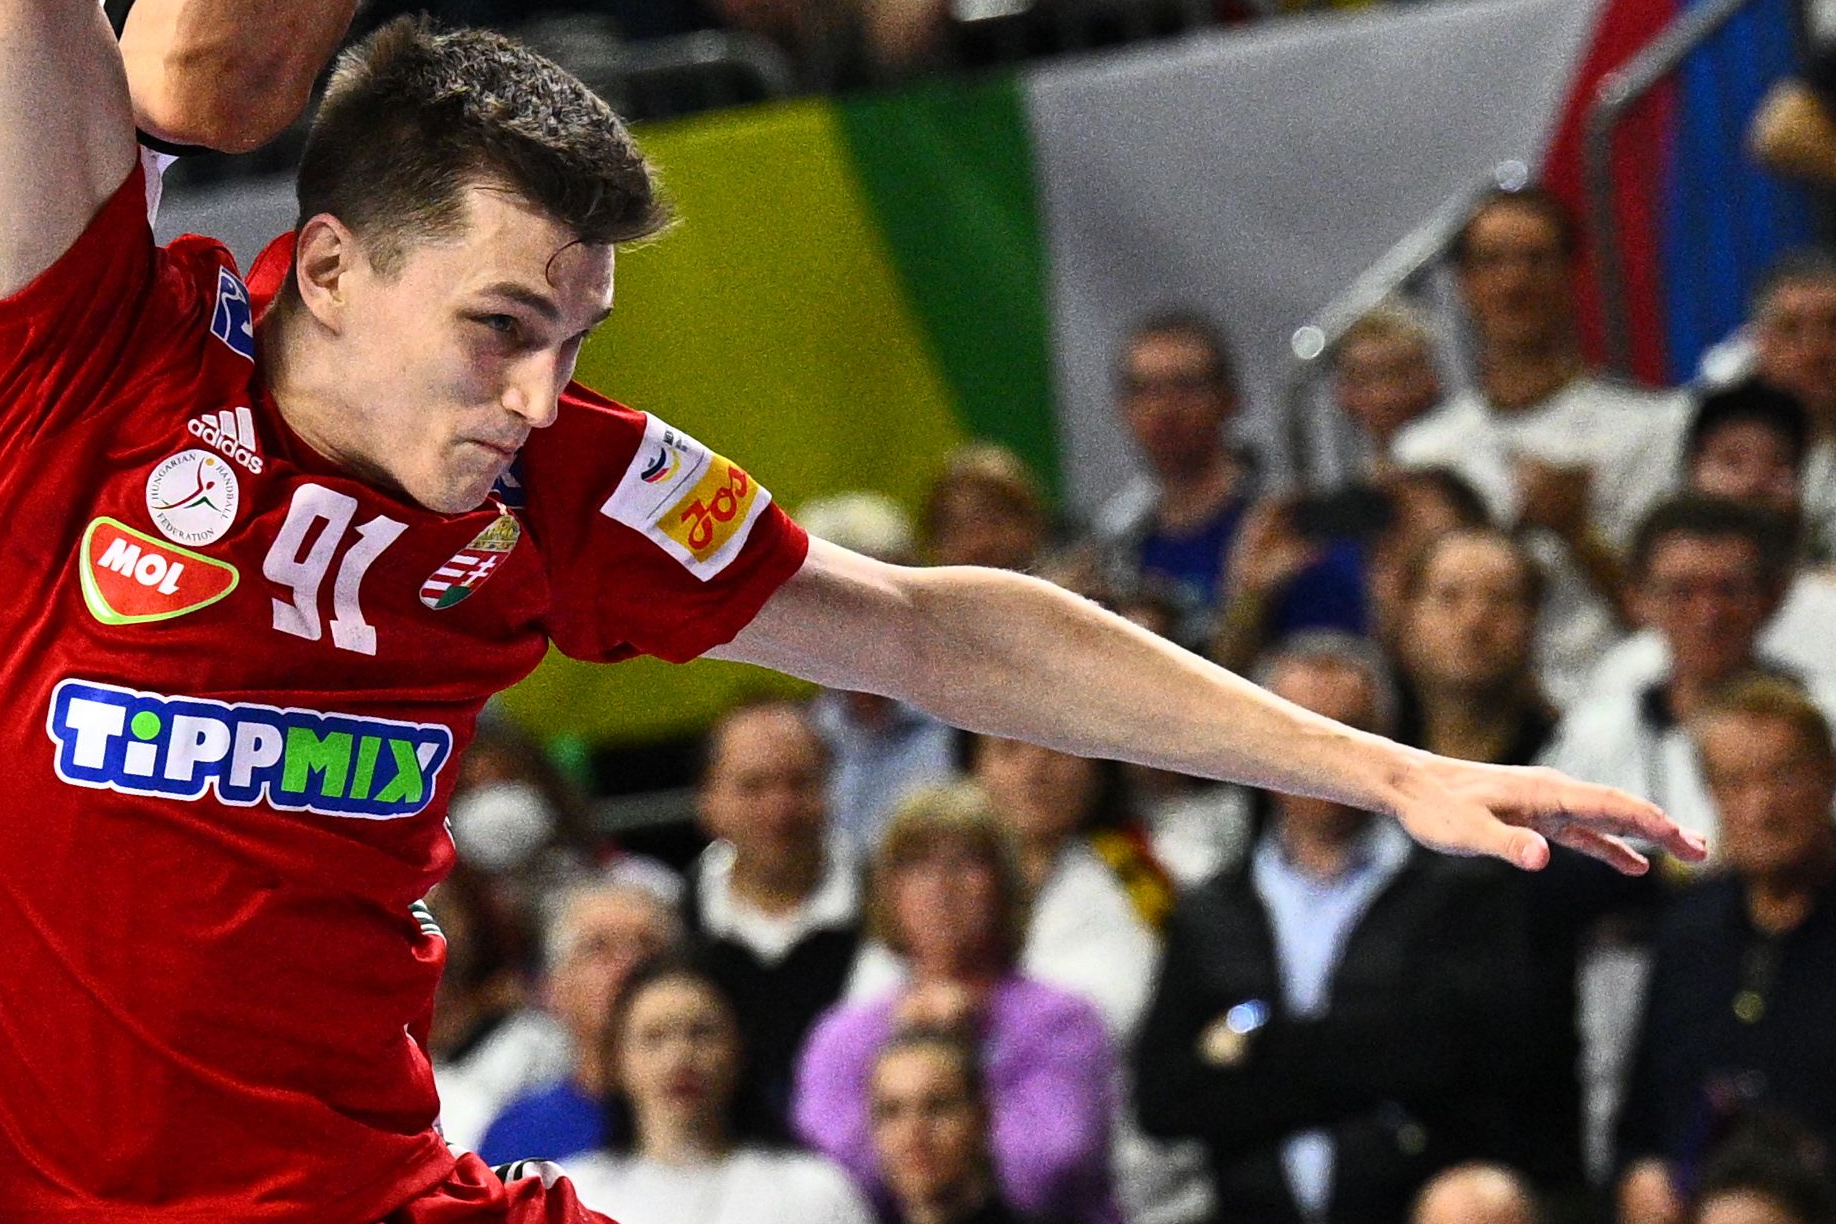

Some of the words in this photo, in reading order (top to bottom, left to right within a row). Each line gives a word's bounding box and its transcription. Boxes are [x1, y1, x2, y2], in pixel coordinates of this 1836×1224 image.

[187, 418, 264, 475] adidas
[151, 452, 197, 500] HUNGARIAN
[215, 464, 235, 520] HANDBALL
[156, 512, 215, 543] FEDERATION
[97, 537, 186, 596] MOL
[263, 483, 410, 656] 91
